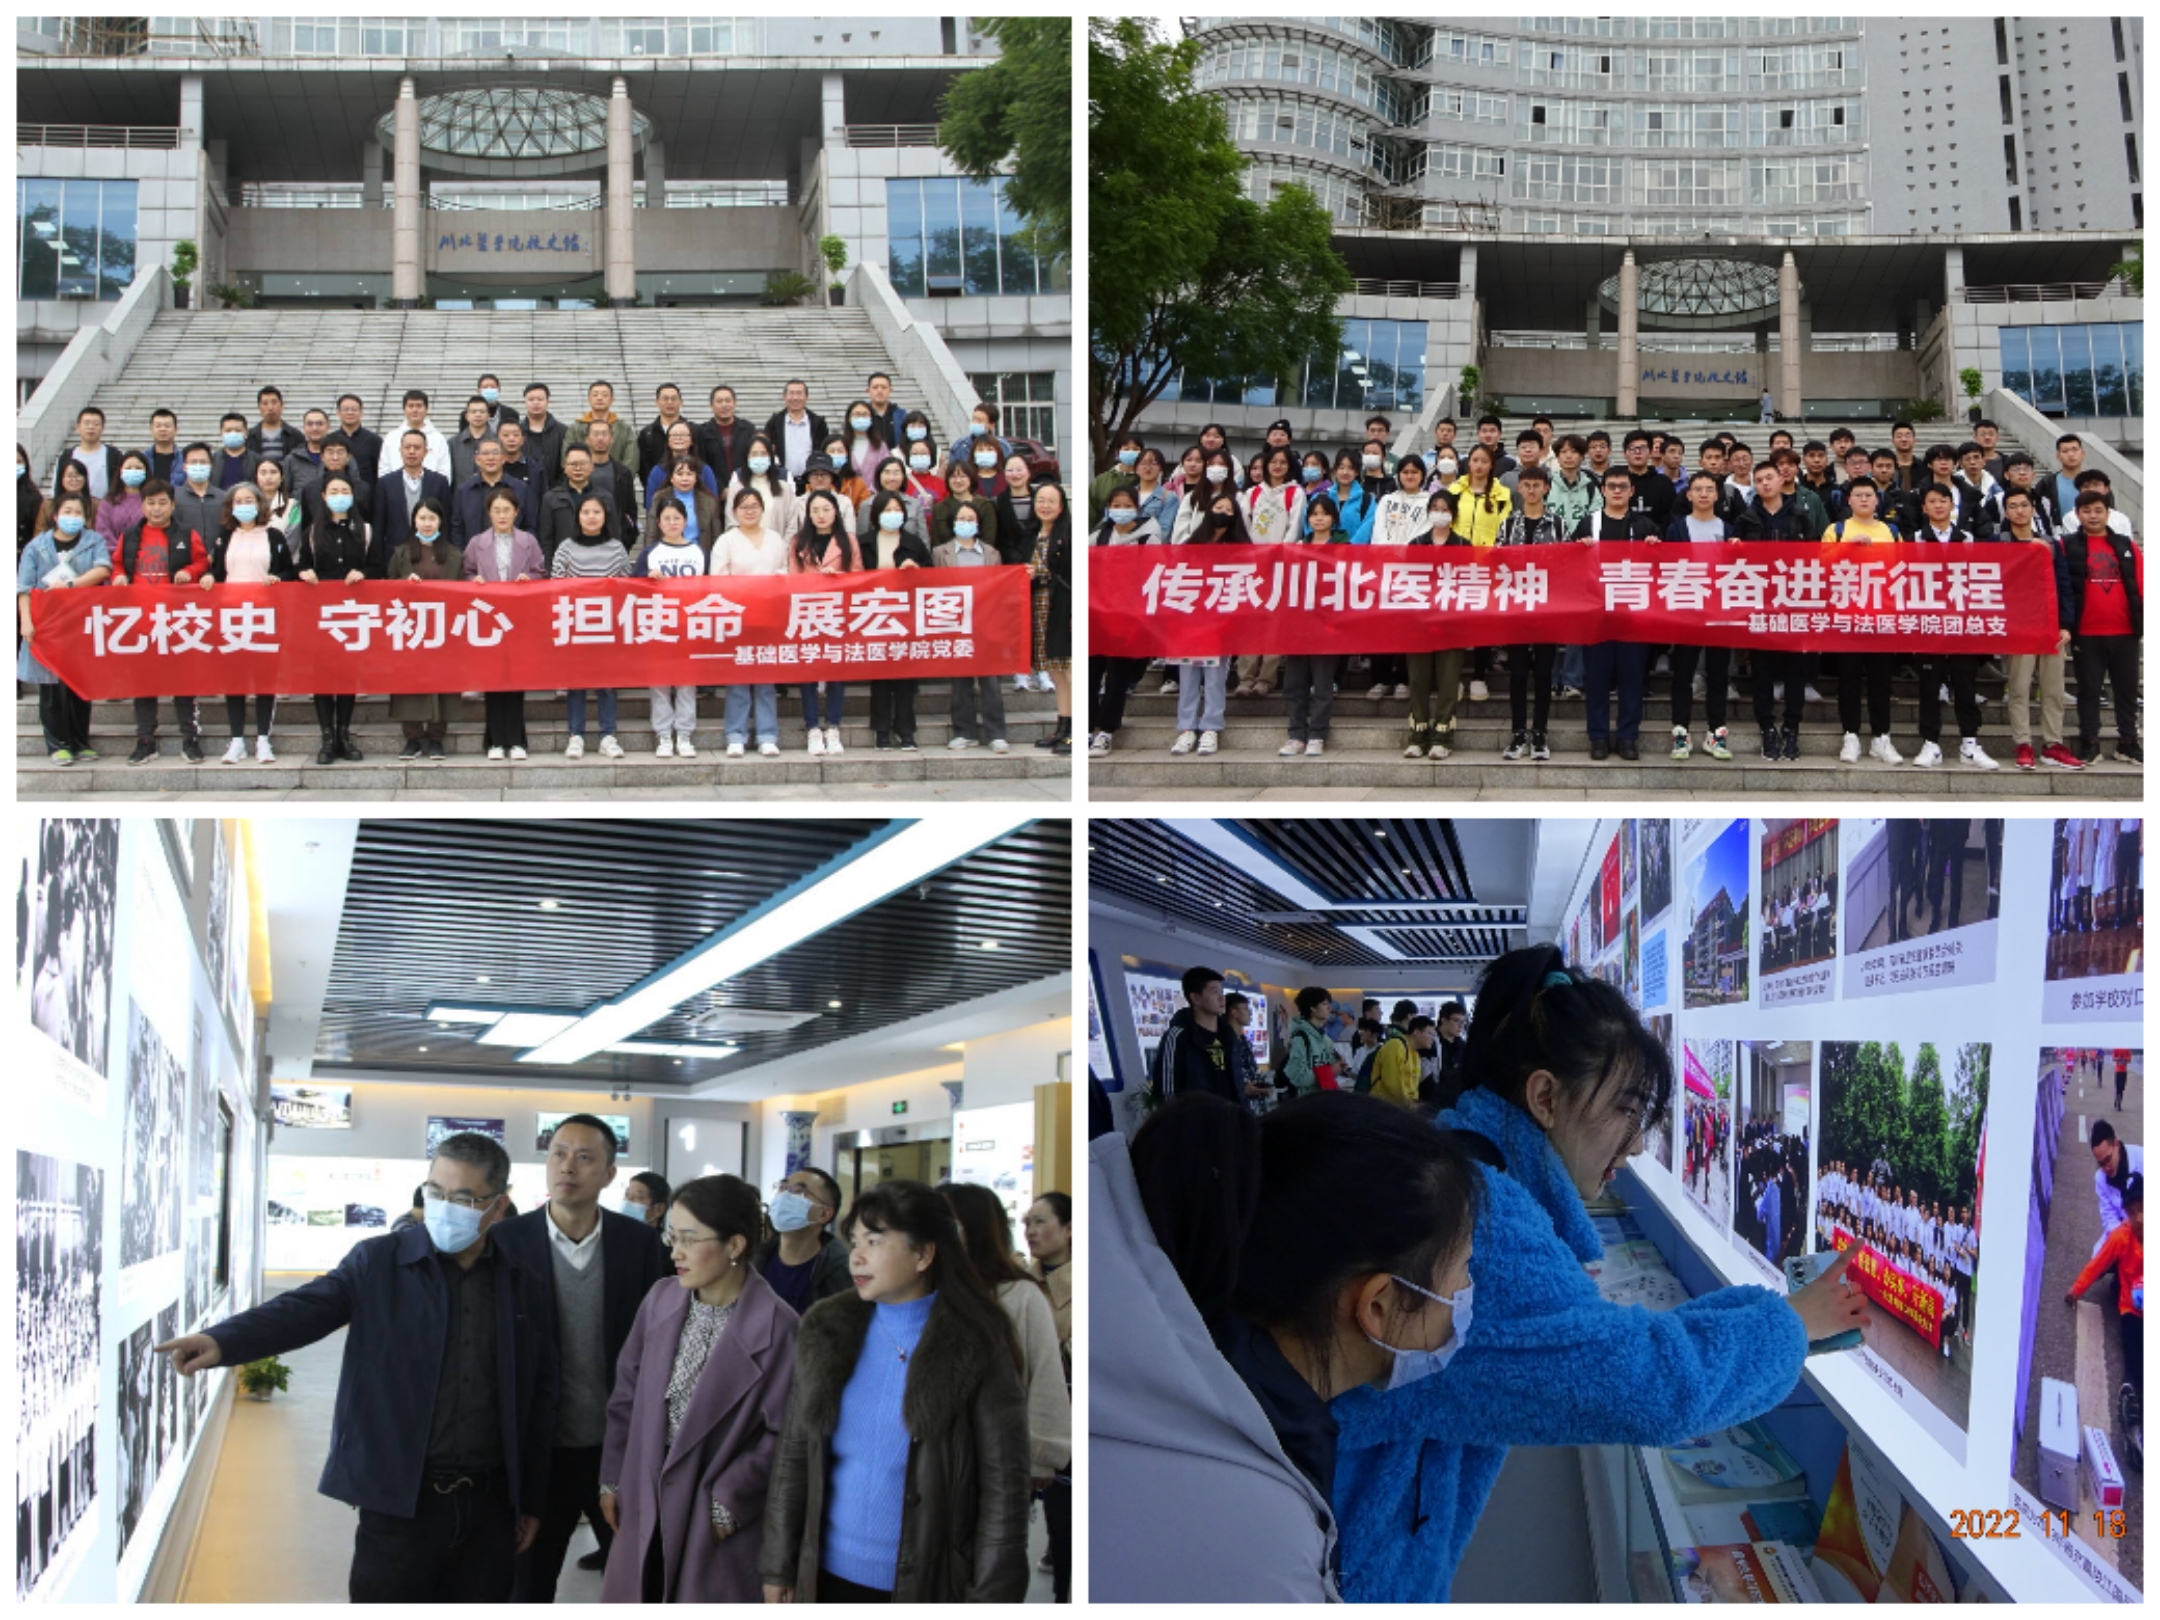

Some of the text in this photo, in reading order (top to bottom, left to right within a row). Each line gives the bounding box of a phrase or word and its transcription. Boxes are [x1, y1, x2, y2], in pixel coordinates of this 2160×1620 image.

[1142, 558, 2005, 615] 传承川北医精神 青春奋进新征程
[84, 585, 974, 657] 忆校史 守初心 担使命 展宏图
